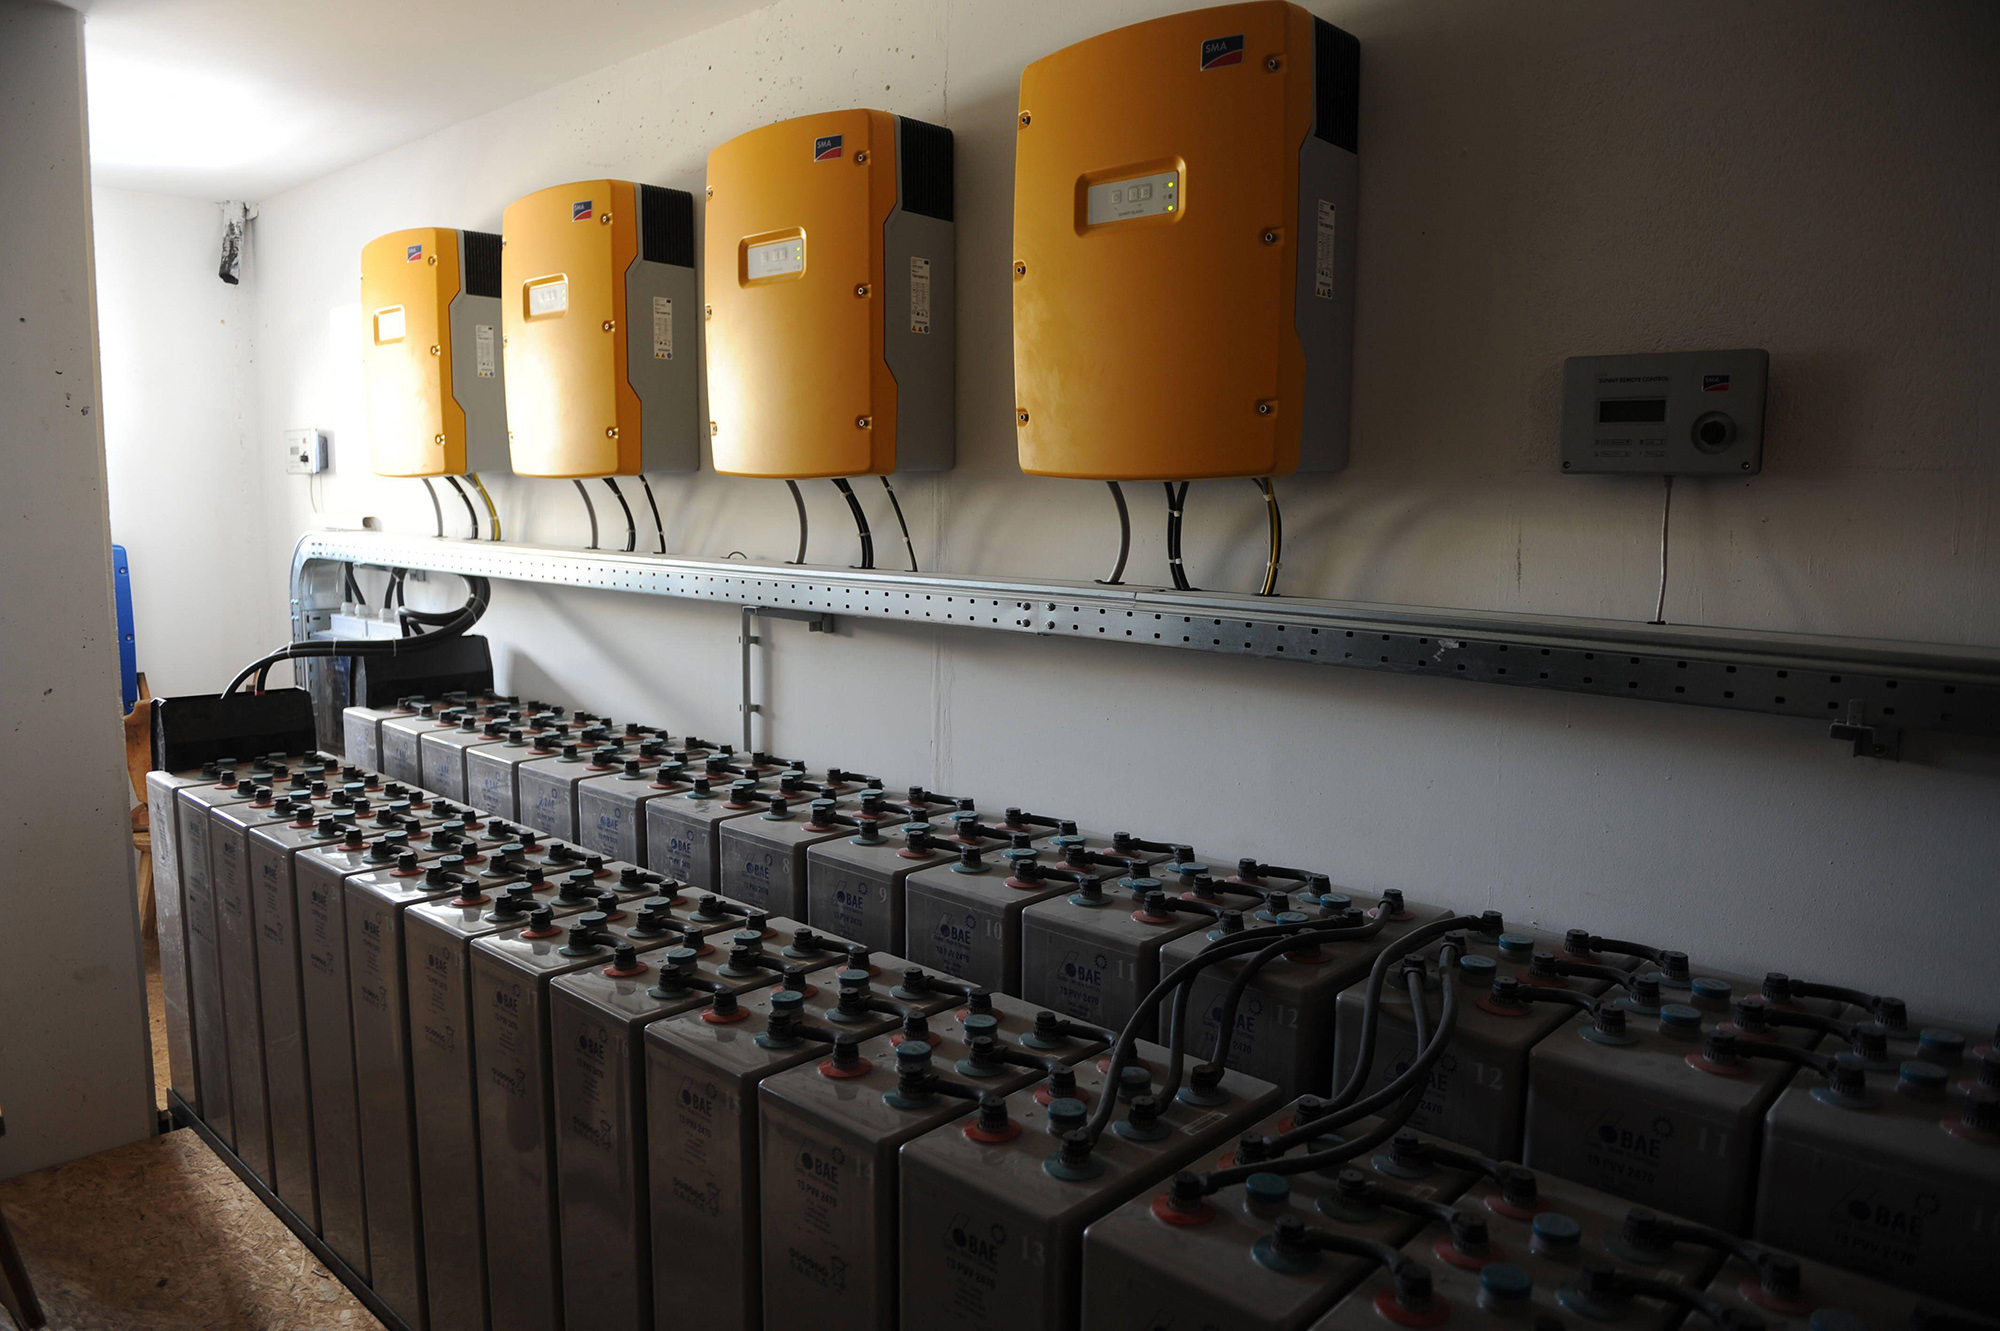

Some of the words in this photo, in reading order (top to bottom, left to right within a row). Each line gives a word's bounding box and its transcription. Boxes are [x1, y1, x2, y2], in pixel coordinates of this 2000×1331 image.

[1205, 41, 1227, 54] SMA
[817, 140, 832, 149] SMA
[1704, 376, 1719, 384] SMA
[607, 817, 618, 830] BAE
[678, 840, 691, 854] BAE
[701, 833, 708, 848] 7
[754, 864, 769, 879] BAE
[783, 858, 790, 874] 8
[846, 893, 863, 910] BAE
[879, 887, 887, 903] 9
[951, 926, 971, 945] BAE
[985, 919, 1003, 941] 10
[1078, 965, 1101, 986] BAE
[1116, 959, 1136, 982] 11
[503, 994, 518, 1013] BAE
[1275, 1004, 1299, 1030] 12
[587, 1038, 604, 1060] BAE
[1232, 1040, 1252, 1055] 2470
[1474, 1062, 1503, 1091] 12
[692, 1093, 713, 1118] BAE
[1420, 1099, 1443, 1115] 2470
[1621, 1129, 1662, 1159] BAE
[1696, 1127, 1727, 1159] 11
[814, 1157, 839, 1185] BAE
[854, 1155, 875, 1184] 14
[1587, 1154, 1601, 1167] 13
[1627, 1166, 1655, 1184] 2470
[1875, 1205, 1924, 1239] BAE
[969, 1234, 998, 1265] BAE
[1021, 1235, 1045, 1268] 13
